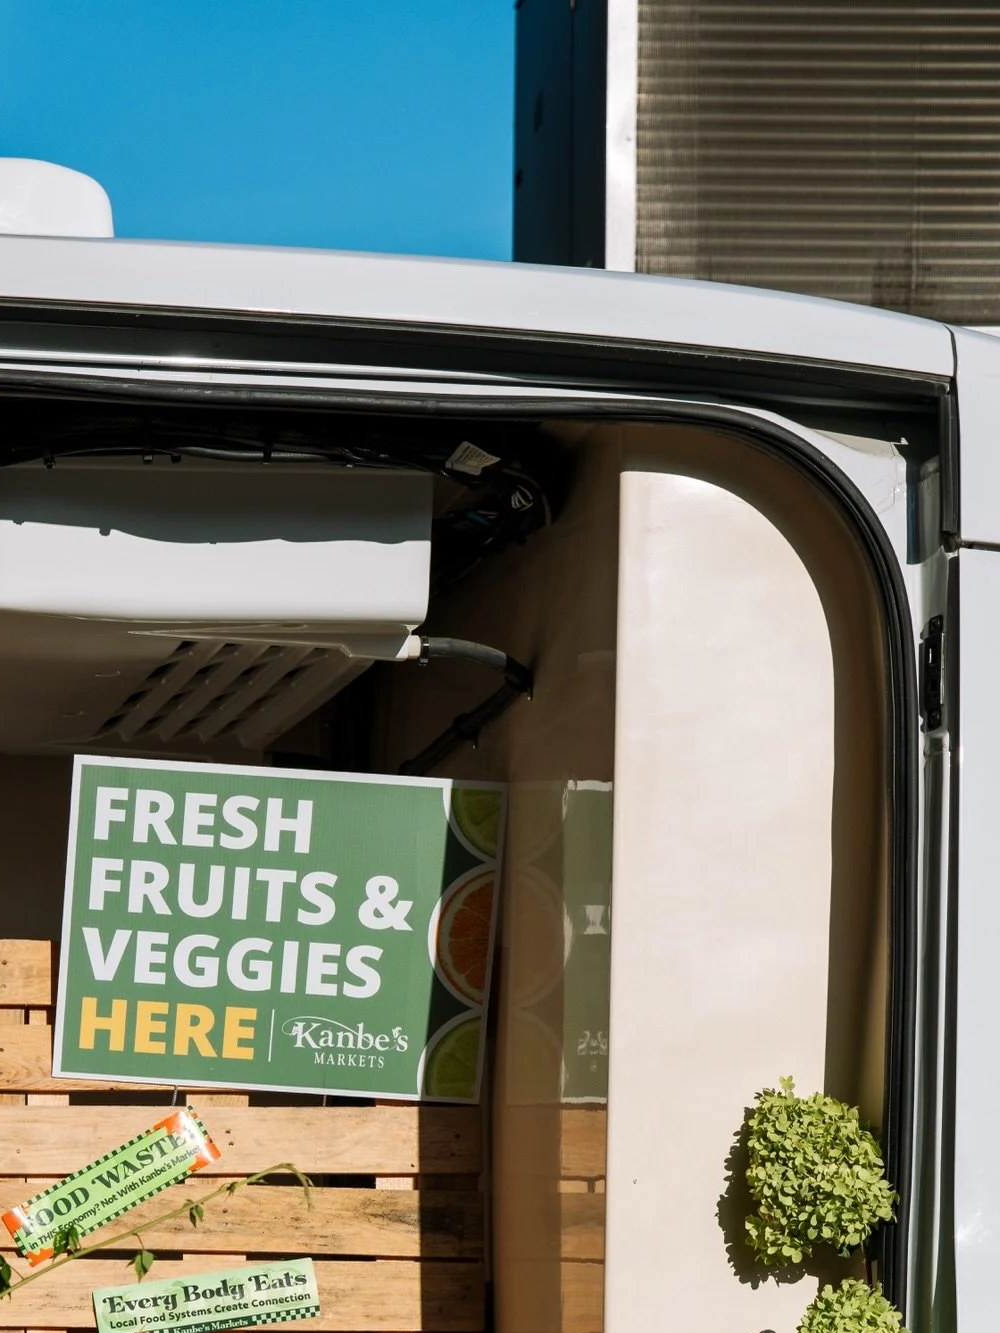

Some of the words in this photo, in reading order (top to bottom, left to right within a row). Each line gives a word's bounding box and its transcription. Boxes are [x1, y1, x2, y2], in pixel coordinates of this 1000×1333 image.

[93, 786, 314, 855] FRESH
[88, 856, 339, 927] FRUITS
[358, 875, 414, 933] &
[82, 926, 384, 999] VEGGIES
[78, 997, 258, 1061] HERE
[290, 1015, 409, 1053] Kanbe's
[314, 1052, 385, 1069] MARKETS
[28, 1240, 39, 1251] in
[37, 1228, 60, 1245] THIS
[58, 1203, 102, 1234] Economy?
[100, 1194, 118, 1208] Not
[115, 1179, 140, 1199] With
[139, 1161, 172, 1185] Kanbe's
[102, 1289, 179, 1314] Every
[182, 1278, 245, 1302] Body
[248, 1271, 308, 1292] Eats
[109, 1317, 138, 1329] Local
[140, 1313, 166, 1325] Food
[168, 1306, 212, 1321] Systems
[214, 1301, 249, 1314] Create
[251, 1291, 311, 1307] Connection
[211, 1318, 249, 1331] Markets
